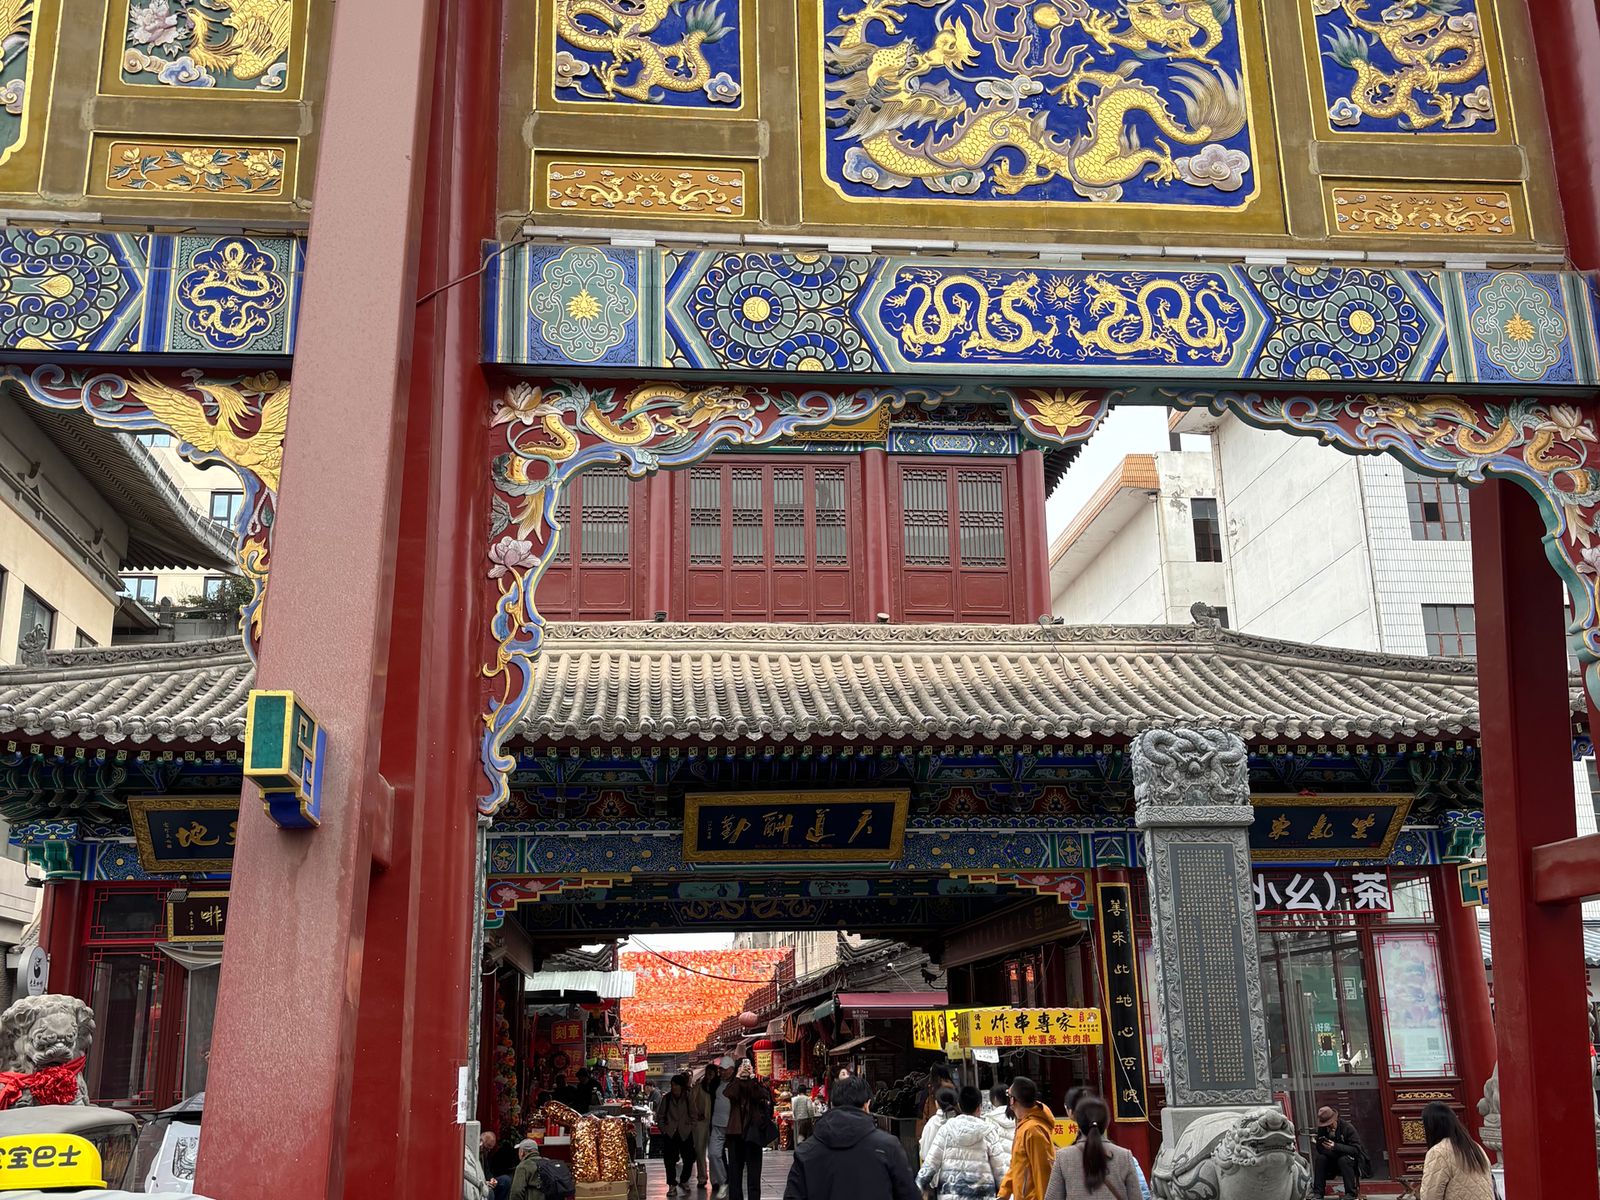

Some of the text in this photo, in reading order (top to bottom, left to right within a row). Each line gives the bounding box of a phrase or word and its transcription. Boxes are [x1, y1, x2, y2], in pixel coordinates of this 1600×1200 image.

[991, 1011, 1076, 1034] 炸串專家
[1028, 1034, 1057, 1045] 炸薯条
[1062, 1034, 1091, 1043] 炸肉串
